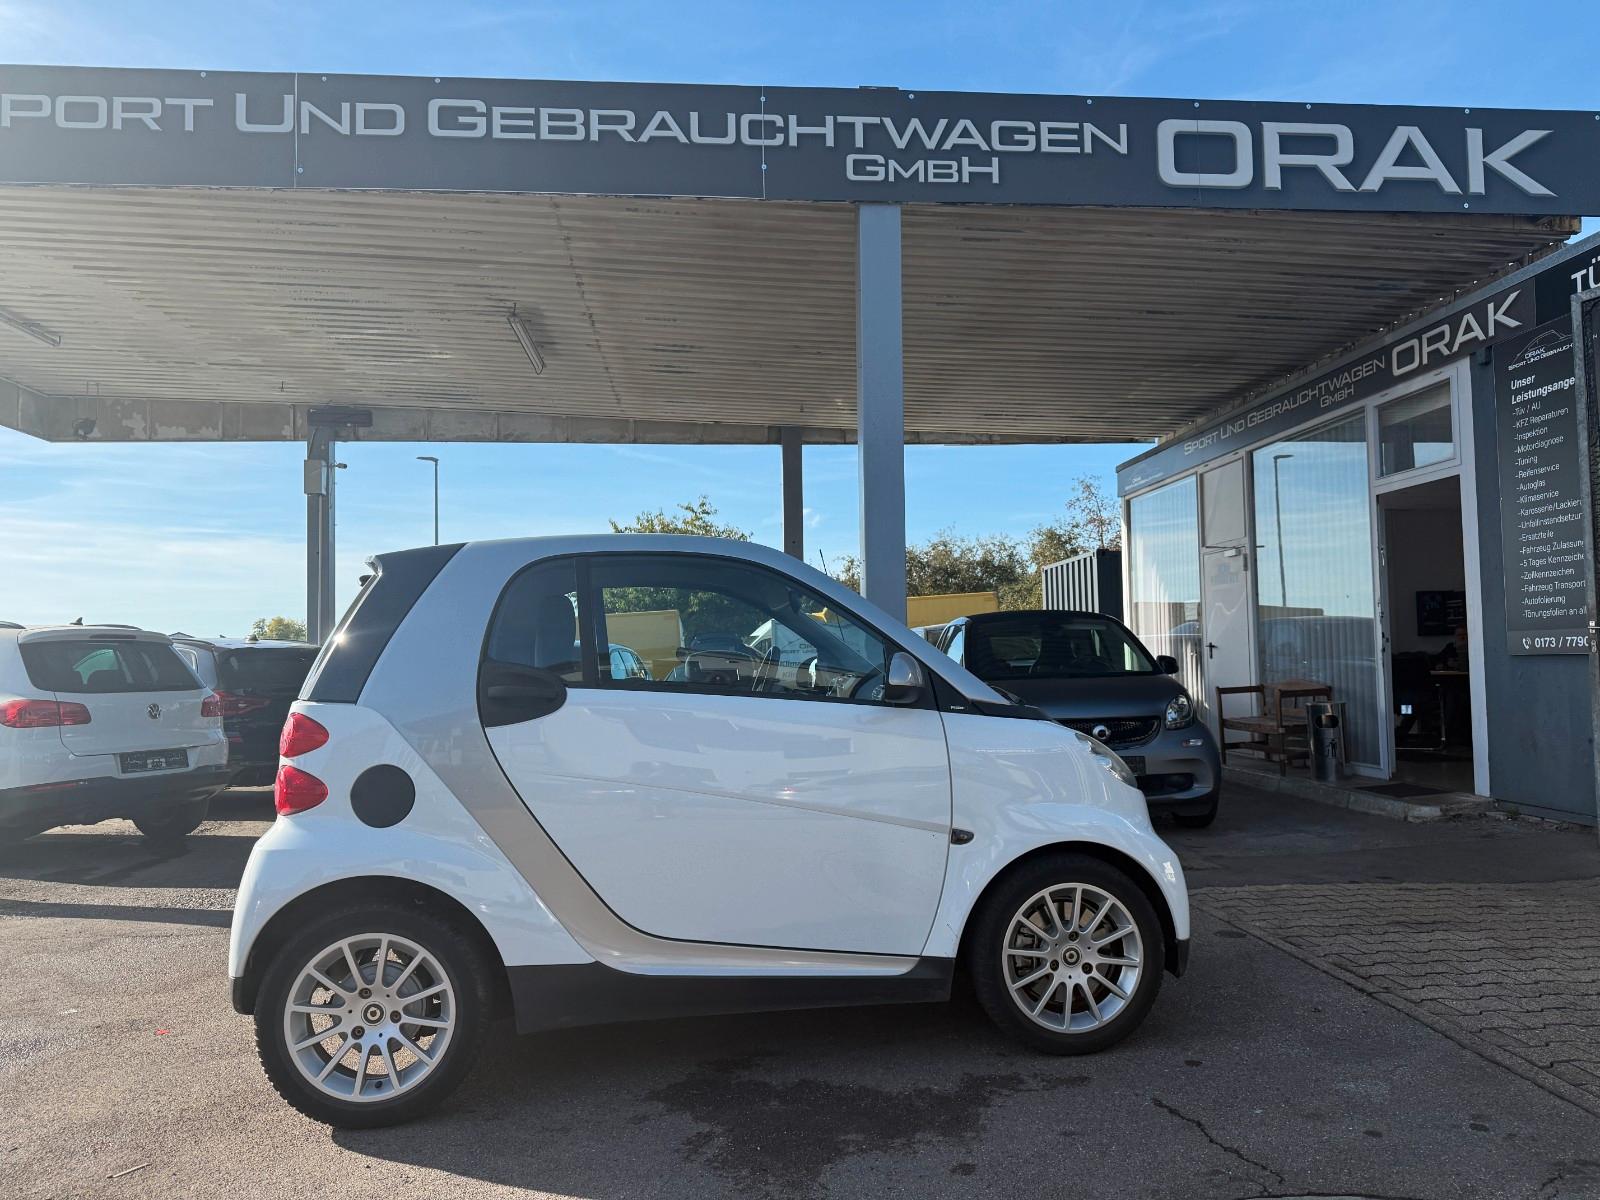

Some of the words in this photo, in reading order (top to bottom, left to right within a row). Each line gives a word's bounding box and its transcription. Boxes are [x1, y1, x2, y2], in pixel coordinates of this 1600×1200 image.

[427, 98, 1128, 155] GEBRAUCHTWAGEN
[1157, 118, 1559, 198] ORAK
[1392, 289, 1523, 377] ORAK
[1524, 347, 1546, 359] ORAK
[1510, 374, 1536, 390] Unser
[1511, 376, 1576, 405] Leistungsange
[1184, 431, 1219, 456] SPORT
[1247, 355, 1386, 428] GEBRAUCHTWAGEN
[1531, 401, 1541, 411] AU
[1529, 407, 1569, 425] Reparaturen
[1529, 557, 1547, 568] Tages
[1568, 607, 1578, 616] an
[1534, 637, 1556, 648] 0173
